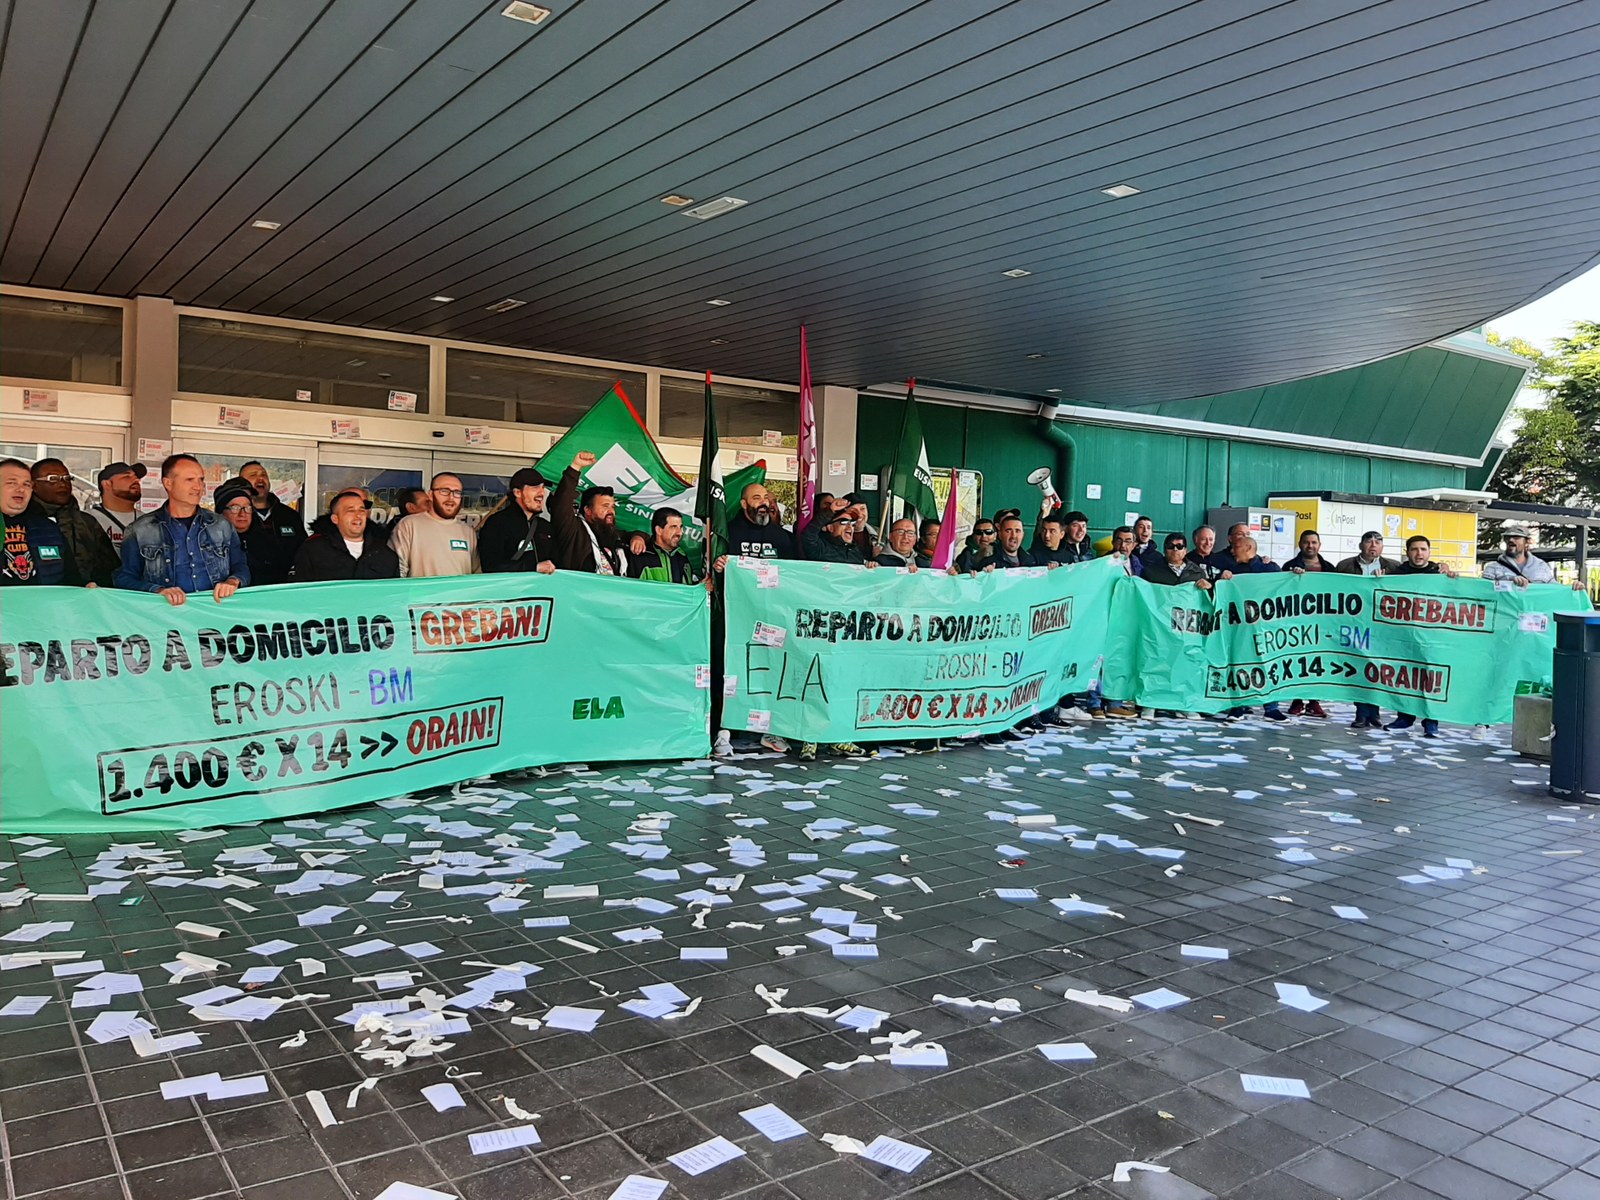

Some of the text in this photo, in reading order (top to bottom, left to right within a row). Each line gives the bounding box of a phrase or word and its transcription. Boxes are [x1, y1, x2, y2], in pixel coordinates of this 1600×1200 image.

[1335, 514, 1356, 524] InPost
[795, 608, 904, 643] REPARTO
[907, 614, 922, 643] A
[1228, 601, 1242, 625] A
[1244, 592, 1363, 624] DOMICILIO
[1379, 595, 1486, 628] GREBAN!
[162, 630, 191, 672] A
[198, 614, 395, 668] DOMICILIO
[419, 605, 542, 646] GREBAN!
[1253, 624, 1319, 656] EROSKI
[1339, 625, 1371, 650] BM
[745, 641, 829, 704] ELA
[1268, 663, 1280, 686] €
[1282, 658, 1293, 681] X
[1297, 655, 1325, 678] 14
[1364, 661, 1444, 694] ORAIN!
[210, 672, 340, 726] EROSKI
[368, 666, 414, 706] BM
[572, 696, 625, 720] ELA
[859, 694, 923, 722] 1.400
[927, 695, 945, 719] €
[945, 694, 962, 719] X
[963, 692, 989, 719] 14
[107, 747, 229, 803] 1.400
[236, 741, 267, 782] €
[275, 734, 303, 777] X
[307, 728, 352, 772] 14
[406, 705, 497, 755] ORAIN!
